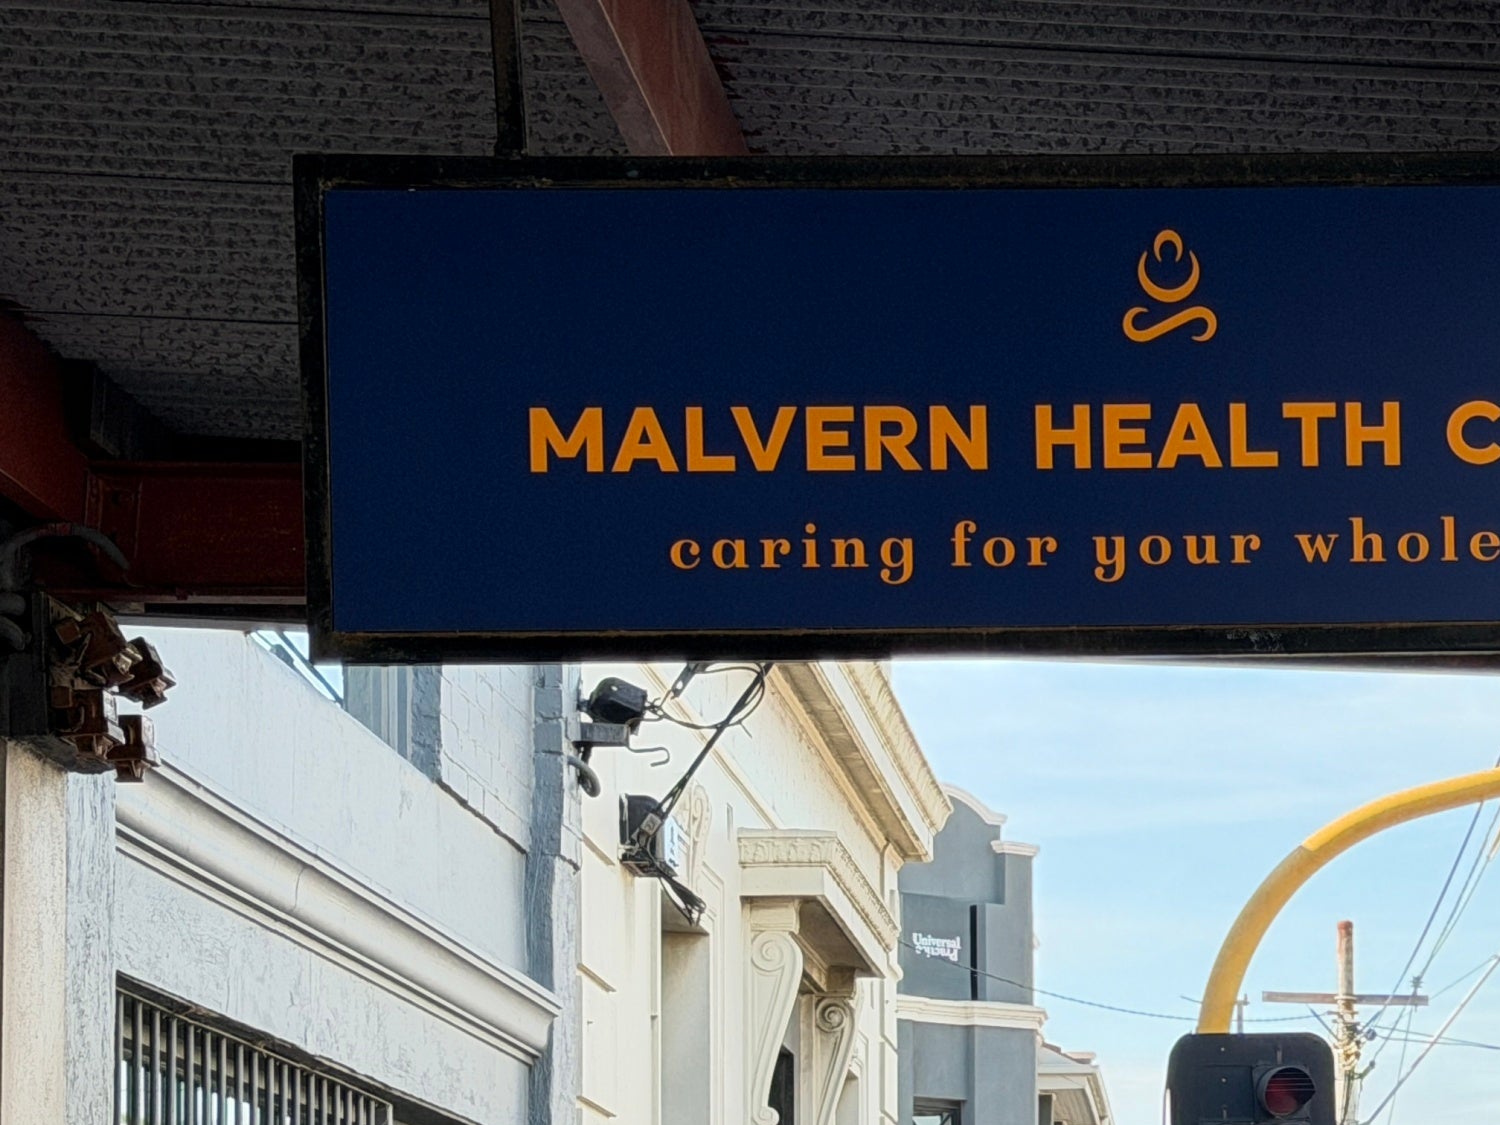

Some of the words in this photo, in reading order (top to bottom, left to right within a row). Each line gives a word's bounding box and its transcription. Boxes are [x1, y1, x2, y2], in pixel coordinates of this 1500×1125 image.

[529, 405, 989, 474] MALVERN
[1035, 401, 1402, 470] HEALTH
[670, 523, 914, 584] caring
[953, 520, 1058, 567] for
[1095, 534, 1261, 582] your
[1297, 516, 1500, 563] whole
[912, 932, 961, 949] Universal
